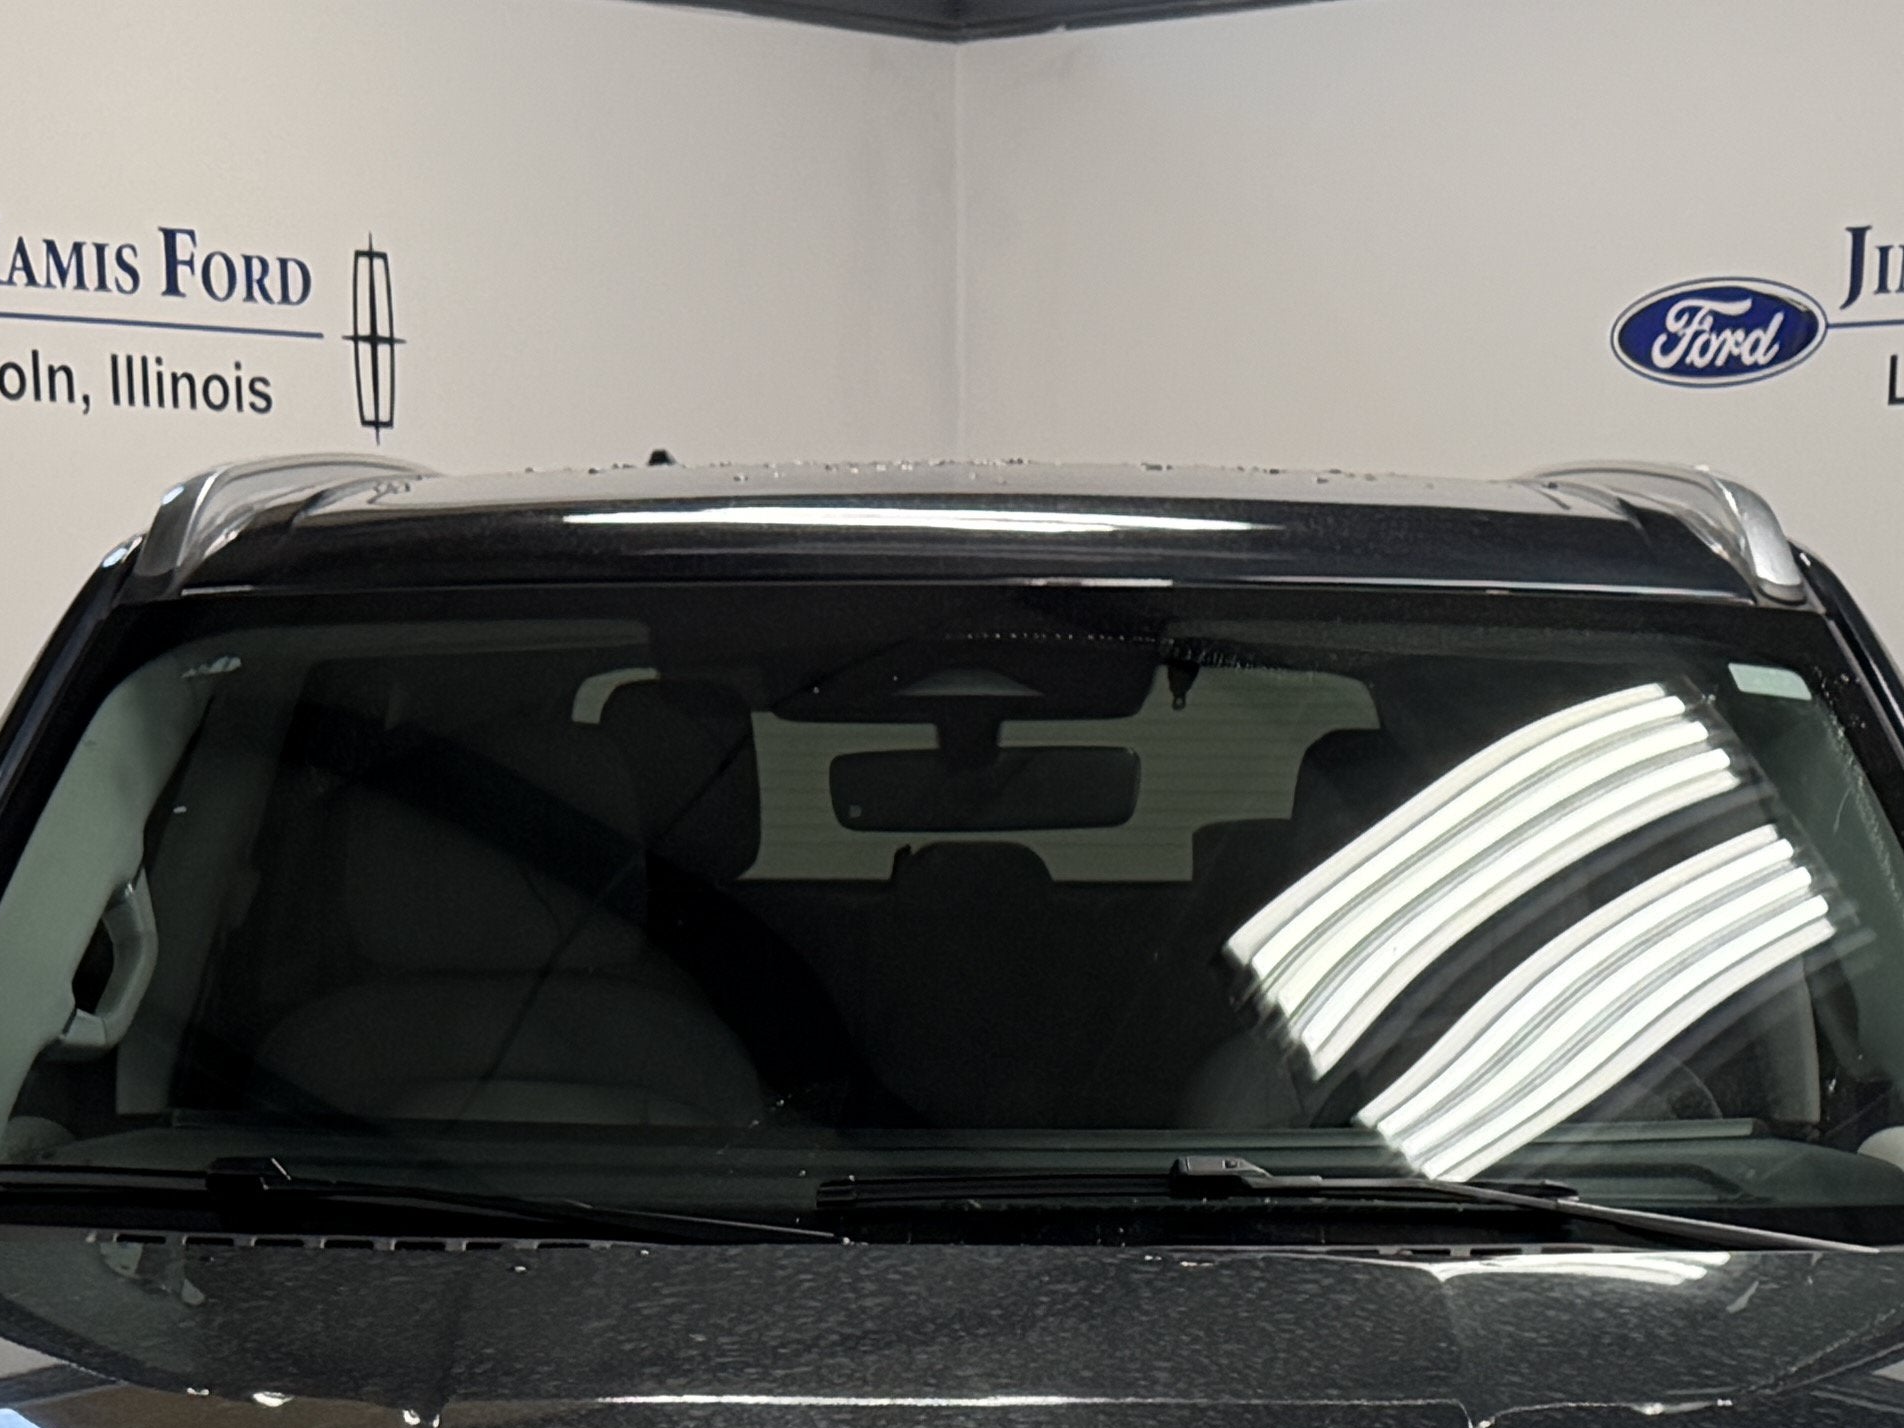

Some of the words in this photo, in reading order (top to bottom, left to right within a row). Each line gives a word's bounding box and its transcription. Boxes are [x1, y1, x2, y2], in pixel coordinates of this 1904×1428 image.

[159, 227, 313, 307] FORD
[1651, 299, 1780, 370] Ford
[110, 354, 274, 414] Illinois
